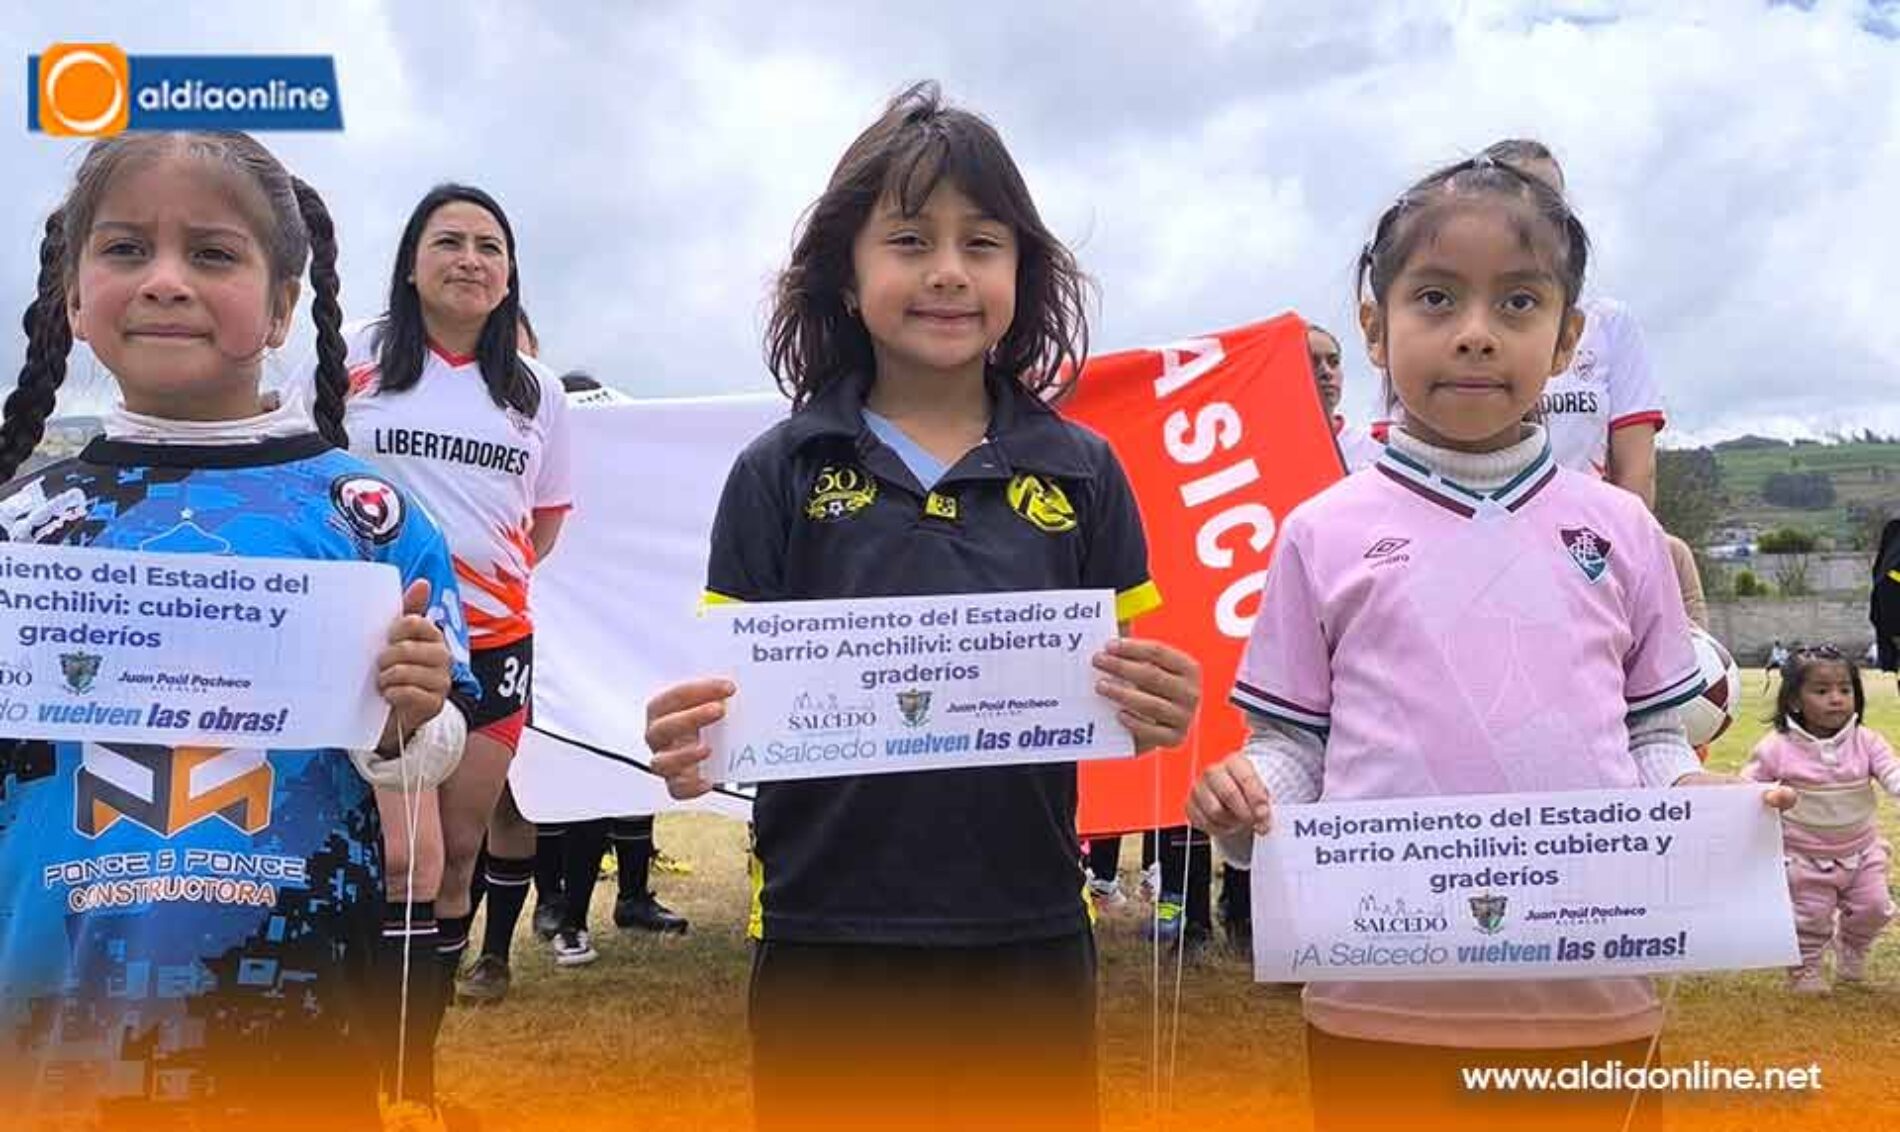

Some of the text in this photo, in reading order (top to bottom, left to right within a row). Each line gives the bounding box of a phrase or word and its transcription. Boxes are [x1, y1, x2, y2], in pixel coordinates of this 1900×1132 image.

[374, 427, 530, 476] LIBERTADORES
[814, 466, 858, 494] 50
[0, 556, 309, 595] iento del Estadio del
[0, 589, 287, 629] Anchilivi: cubierta y
[732, 600, 1102, 638] Mejoramiento del Estadio del
[18, 622, 163, 649] graderíos
[752, 630, 1083, 664] barrio Anchilivi: cubierta y
[0, 668, 33, 687] DO
[117, 671, 153, 684] Juan
[190, 674, 252, 689] Pacheco
[497, 655, 530, 706] 34
[861, 662, 981, 690] graderíos
[38, 701, 143, 728] vuelven
[146, 702, 192, 729] las
[197, 705, 289, 733] obras!
[1007, 697, 1059, 710] Pacheco
[787, 711, 878, 730] SALCEDO
[764, 737, 877, 767] Salcedo
[884, 731, 971, 756] vuelven
[974, 727, 1011, 751] las
[1018, 722, 1095, 748] obras!
[1293, 800, 1692, 840] Mejoramiento del Estadio del
[1315, 832, 1674, 866] barrio Anchilivi: cubierta y
[44, 851, 149, 889] PONCE
[185, 849, 307, 883] PONCE
[1428, 865, 1560, 894] graderíos
[1353, 917, 1448, 933] SALCEDO
[1524, 909, 1557, 922] Juan
[1591, 904, 1647, 918] Pacheco
[1328, 940, 1449, 967] Salcedo
[1456, 938, 1552, 964] vuelven
[1557, 935, 1597, 961] las
[1604, 931, 1688, 959] obras!
